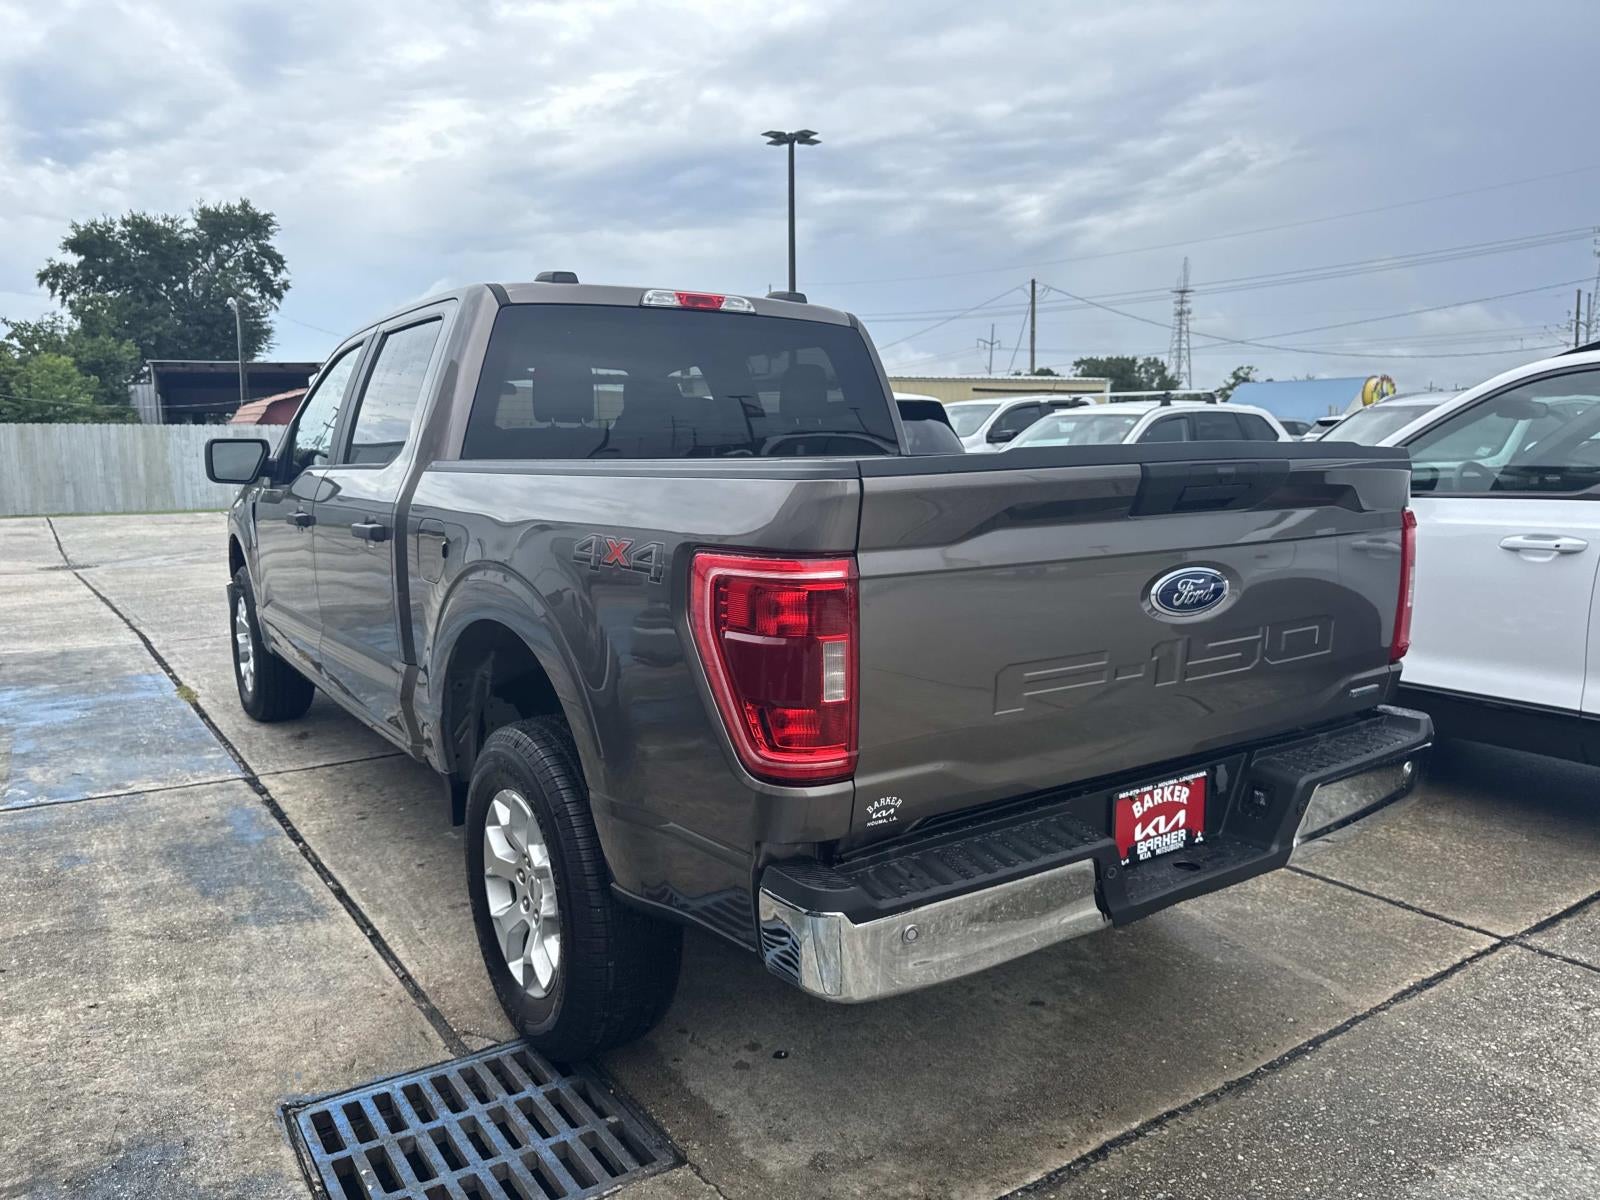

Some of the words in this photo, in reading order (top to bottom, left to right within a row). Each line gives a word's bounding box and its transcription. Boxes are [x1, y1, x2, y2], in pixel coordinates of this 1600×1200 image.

[1172, 578, 1215, 606] Ford
[993, 615, 1335, 716] F-150
[866, 796, 903, 814] BARKER
[1131, 785, 1190, 819] BARKER
[1134, 809, 1187, 841] KIA
[1139, 852, 1152, 861] KIA
